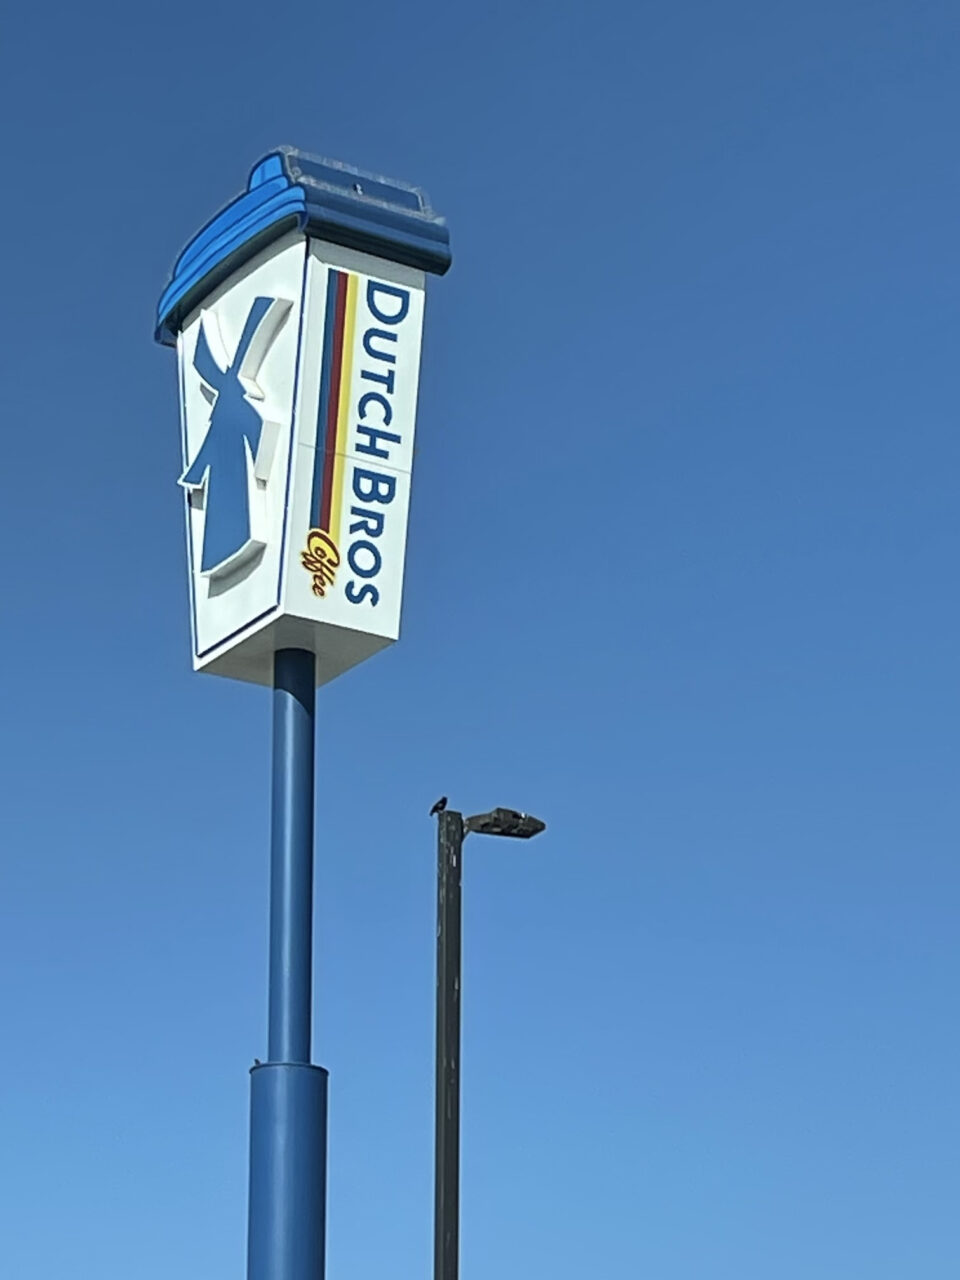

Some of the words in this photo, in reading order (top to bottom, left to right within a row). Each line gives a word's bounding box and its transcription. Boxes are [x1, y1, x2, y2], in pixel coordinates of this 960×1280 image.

[355, 279, 411, 460] DUTCH
[301, 530, 341, 597] Coffee
[345, 466, 397, 608] BROS
